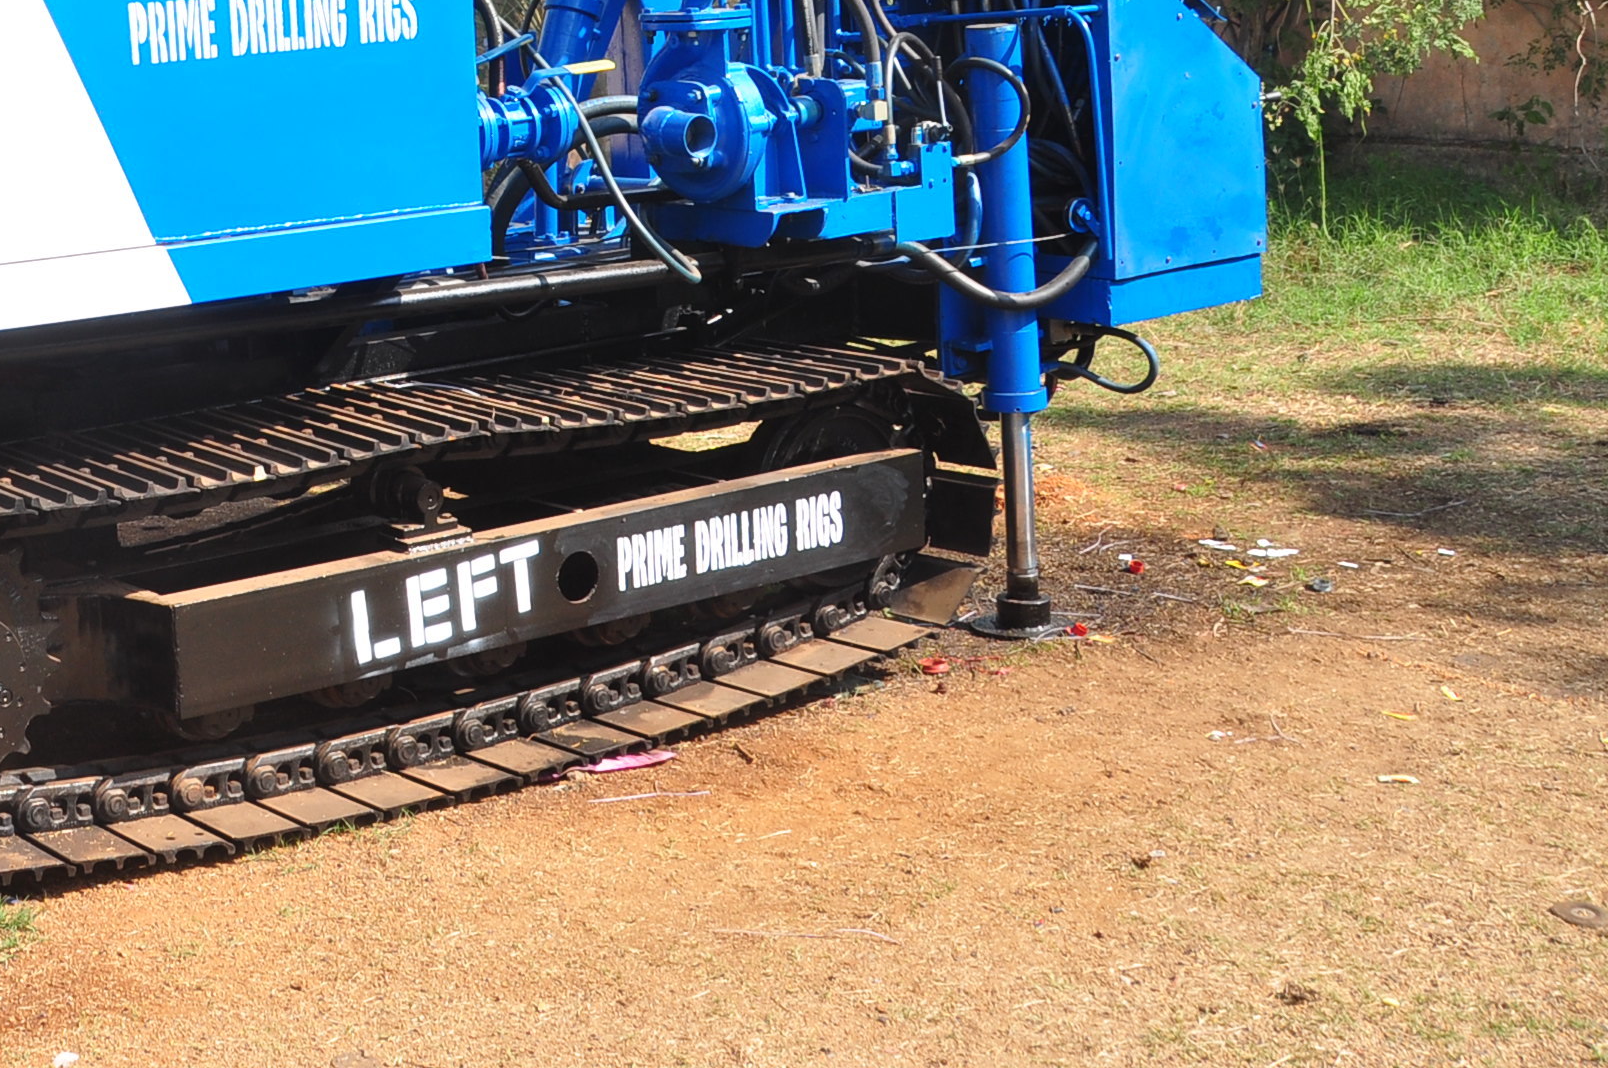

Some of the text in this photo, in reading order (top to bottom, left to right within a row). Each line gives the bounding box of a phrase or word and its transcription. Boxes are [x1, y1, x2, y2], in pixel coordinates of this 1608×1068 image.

[616, 490, 844, 592] PRIME DRILLING RIGS
[350, 538, 540, 666] LEFT
